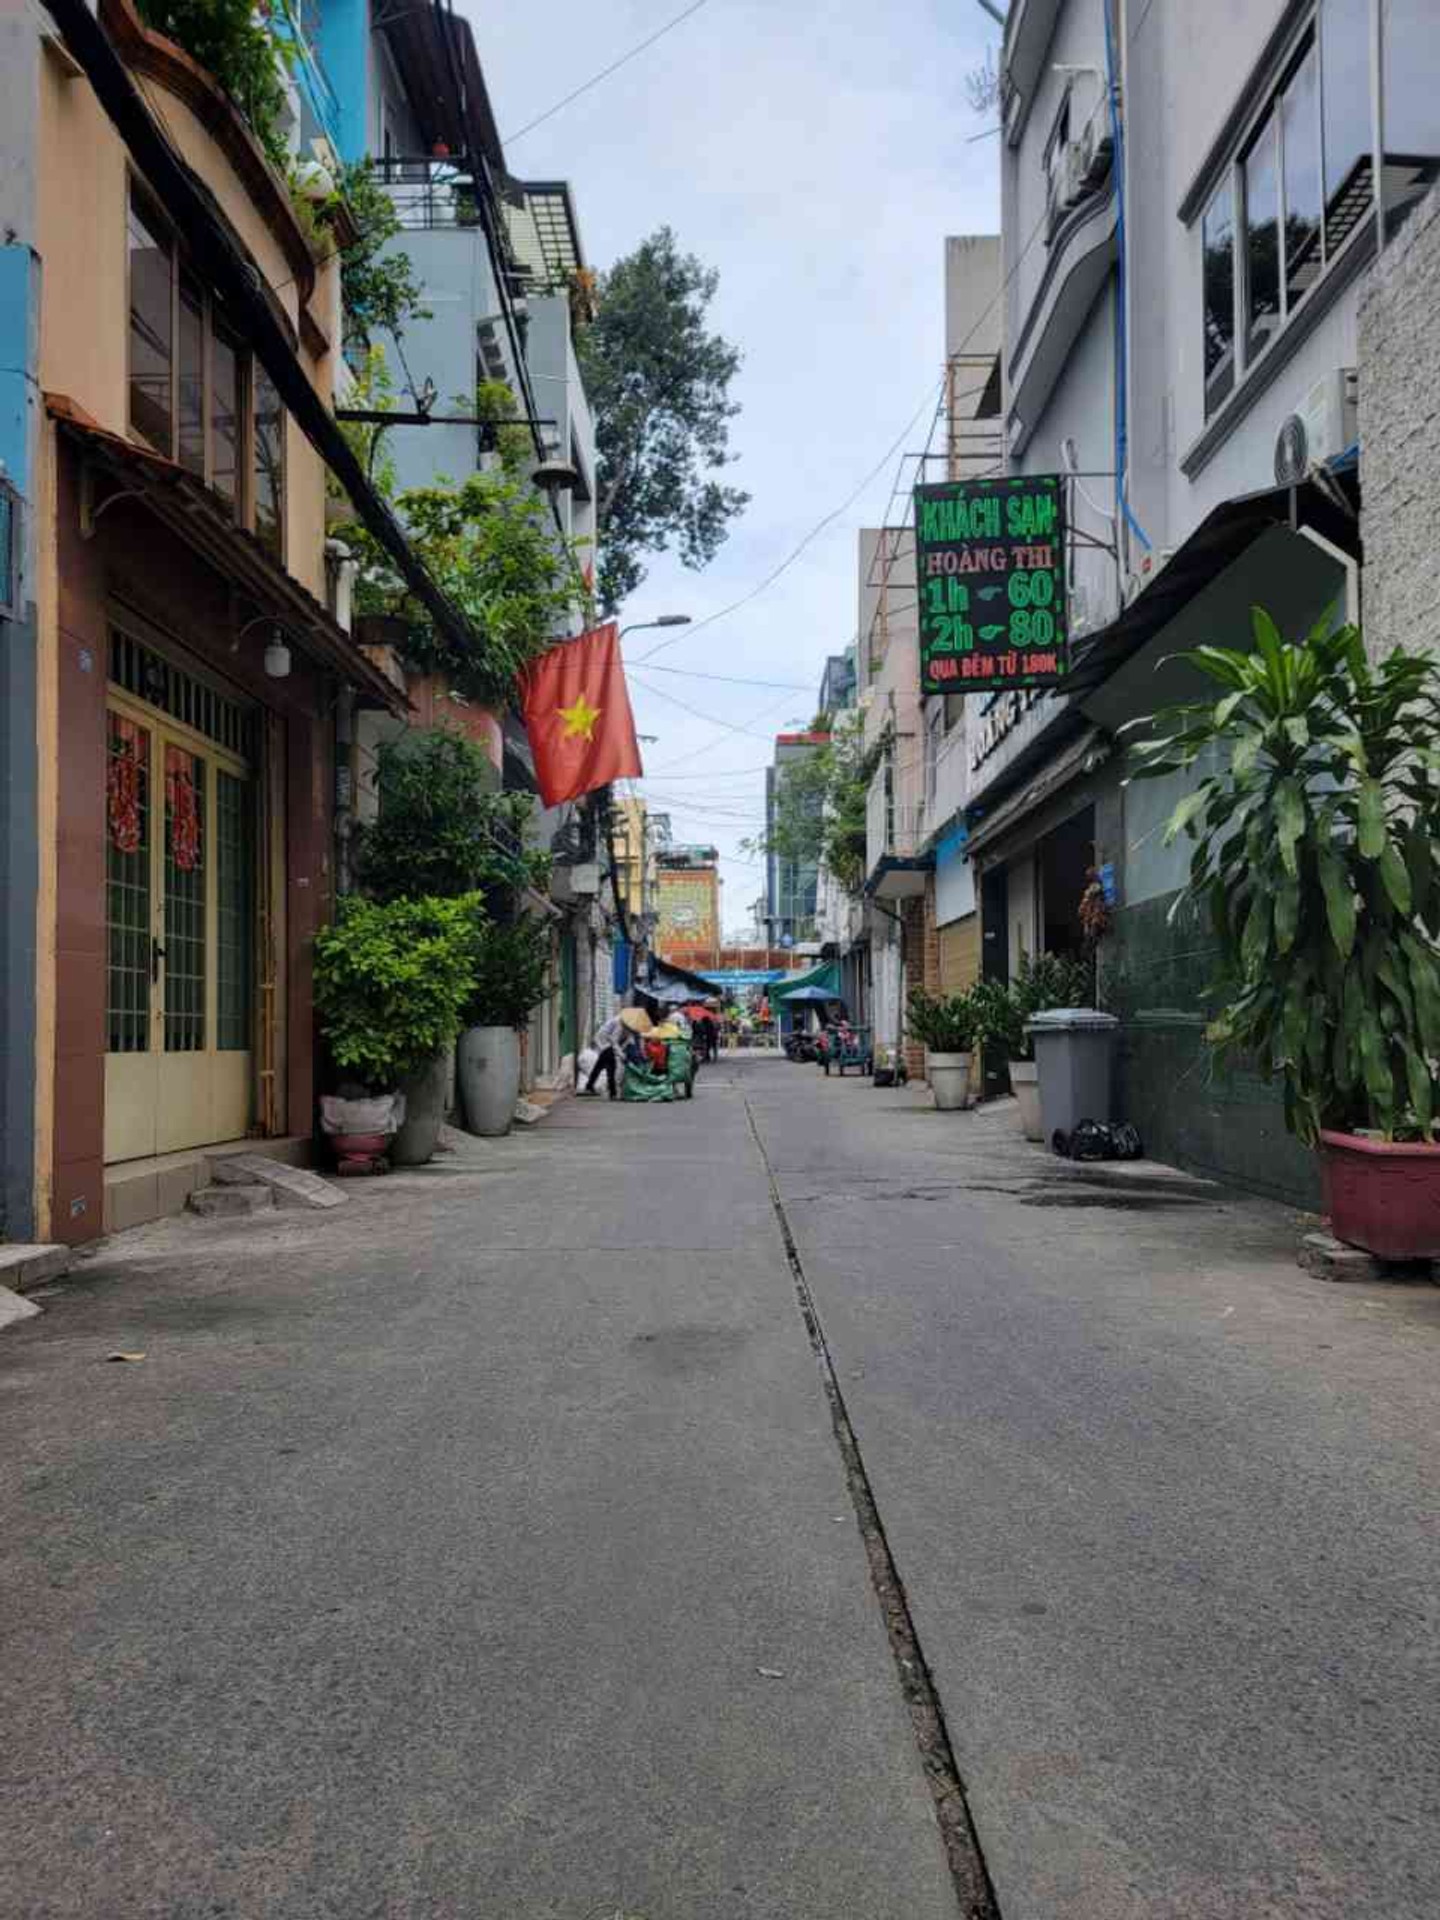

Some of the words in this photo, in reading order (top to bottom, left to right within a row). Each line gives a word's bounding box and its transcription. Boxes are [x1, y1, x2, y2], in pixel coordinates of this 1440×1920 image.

[923, 489, 1000, 541] KHÁCH
[926, 543, 1007, 575] HOÀNG
[1012, 545, 1054, 569] THI
[929, 576, 969, 613] 1h
[1008, 570, 1053, 608] 60
[930, 616, 973, 651] 2h
[1009, 610, 1054, 646] 80
[930, 657, 958, 681] QUA
